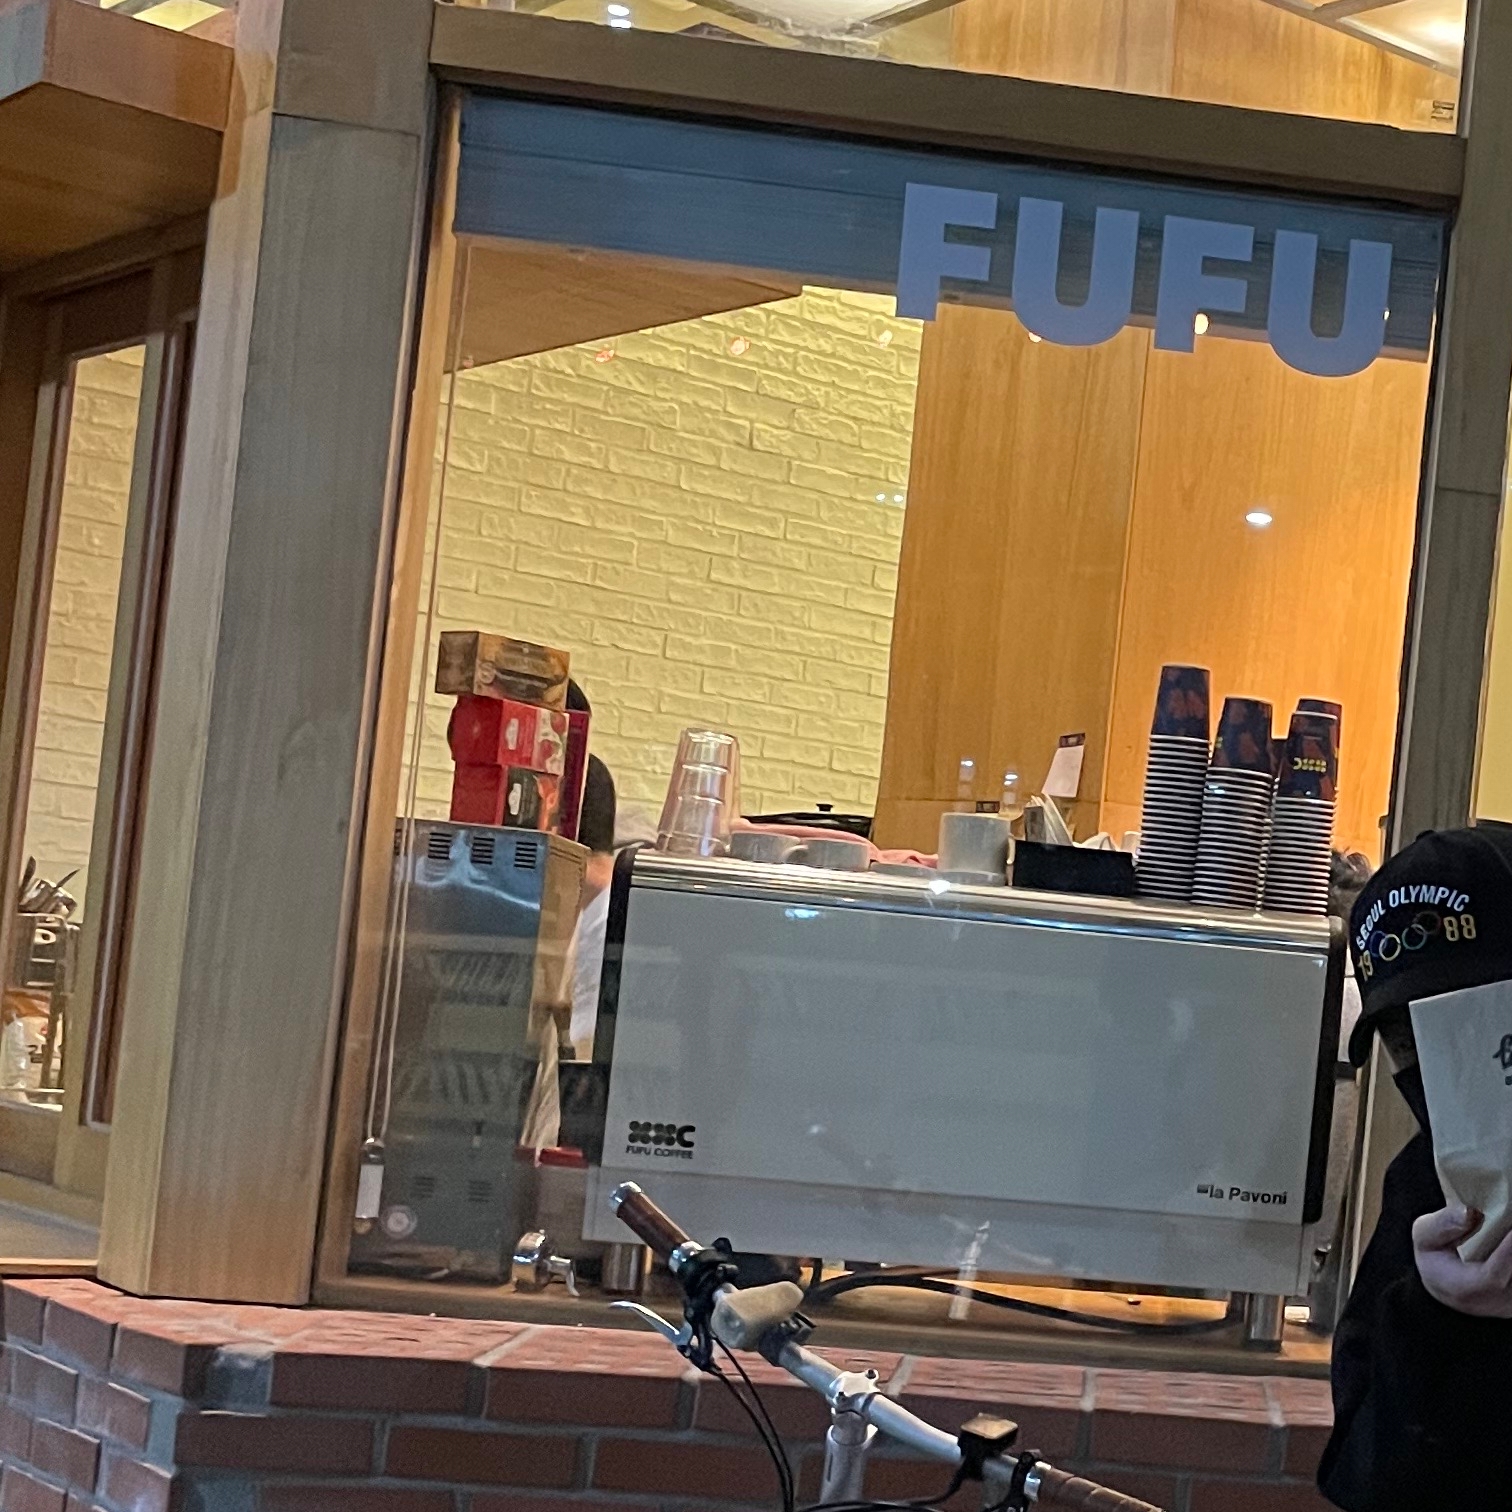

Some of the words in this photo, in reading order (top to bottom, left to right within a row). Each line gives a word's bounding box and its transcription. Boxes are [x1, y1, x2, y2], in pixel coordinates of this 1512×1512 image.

[896, 182, 1393, 378] FUFU
[1356, 899, 1386, 951] SEOUL
[1388, 884, 1470, 912] OLYMPIC
[1358, 950, 1374, 982] 19
[1443, 913, 1477, 942] 88
[625, 1144, 652, 1156] FUFU
[654, 1147, 694, 1160] COFFEE
[1209, 1184, 1225, 1199] la
[1228, 1186, 1288, 1205] Pavoni
